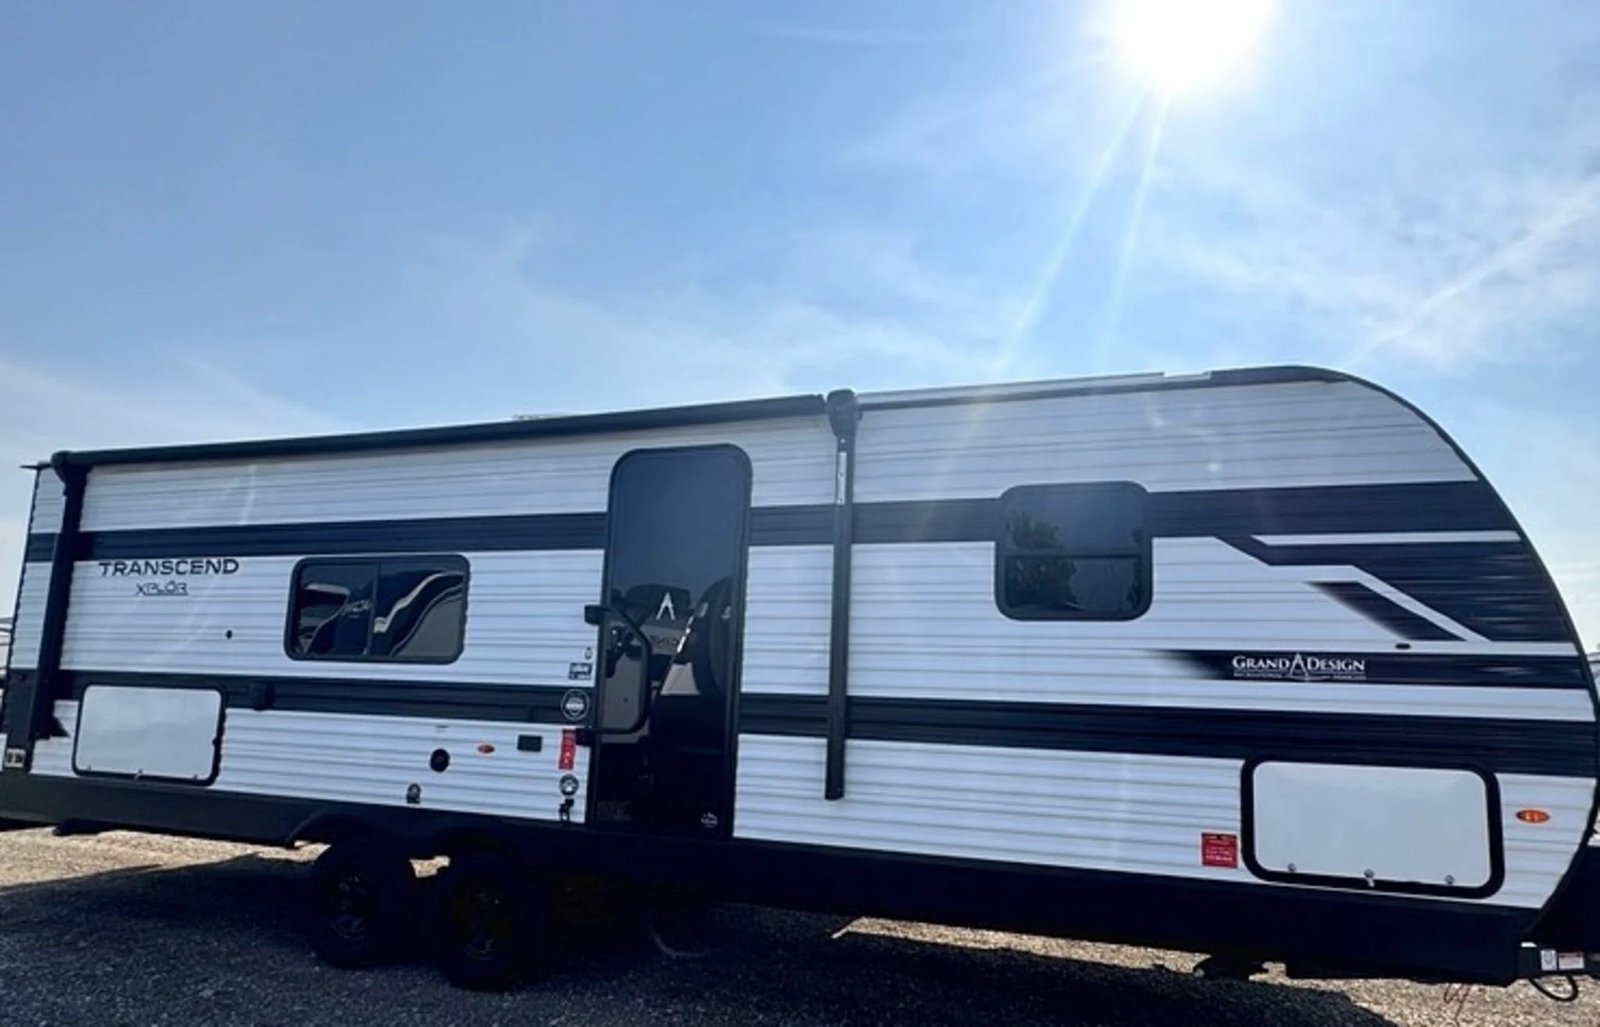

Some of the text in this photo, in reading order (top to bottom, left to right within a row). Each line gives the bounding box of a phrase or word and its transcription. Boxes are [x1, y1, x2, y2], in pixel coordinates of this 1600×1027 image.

[98, 558, 240, 577] TRANSCEND
[135, 580, 189, 597] XPLOR
[1231, 655, 1365, 671] GRAND DESIGN
